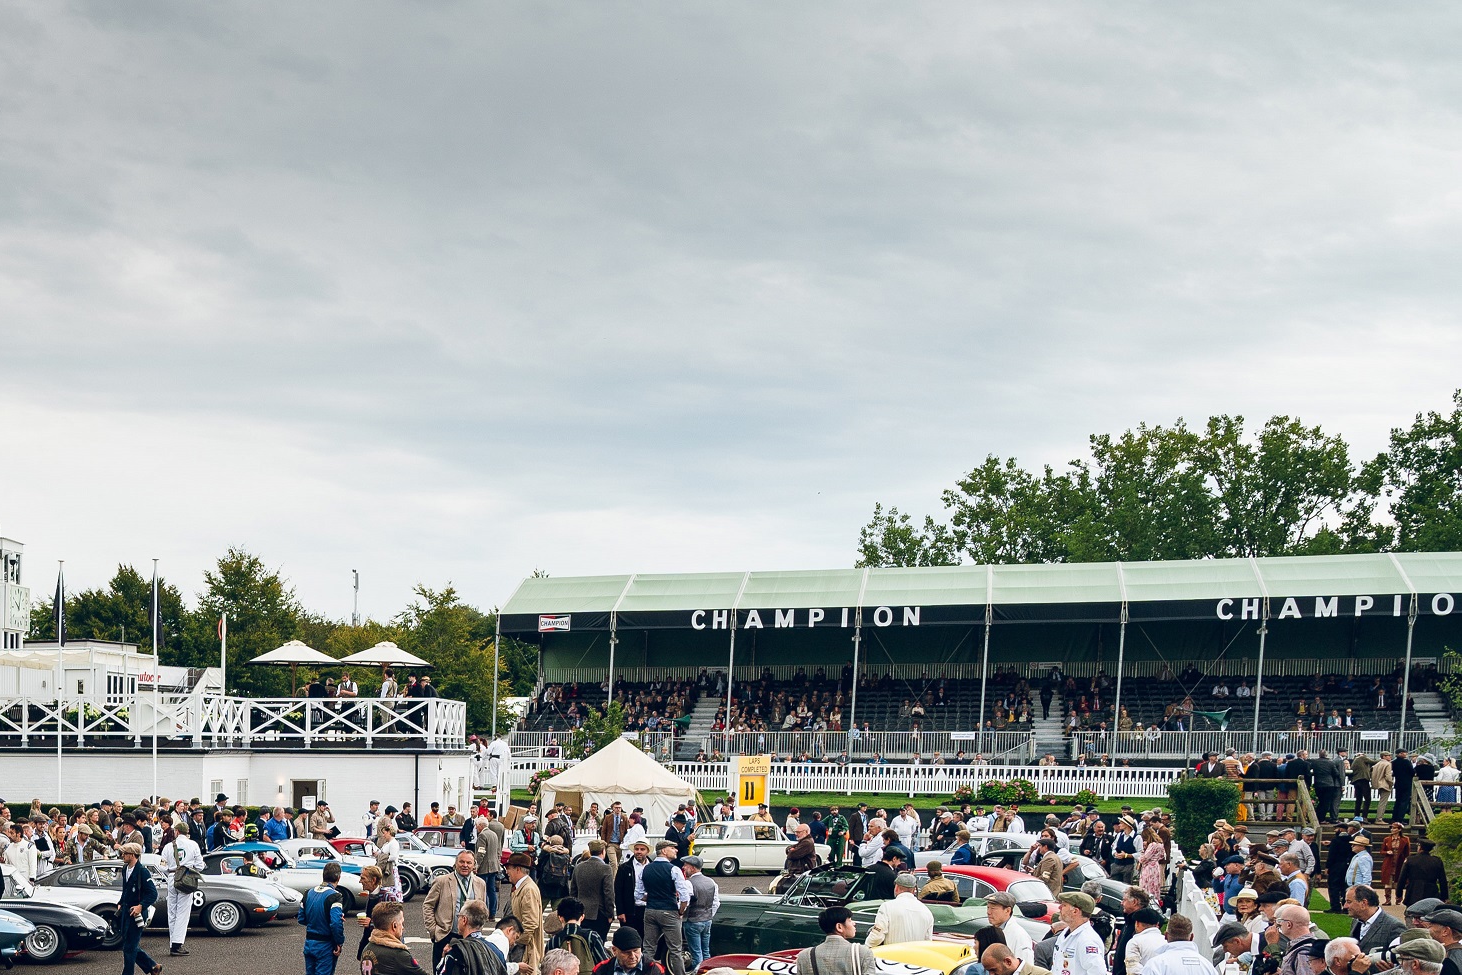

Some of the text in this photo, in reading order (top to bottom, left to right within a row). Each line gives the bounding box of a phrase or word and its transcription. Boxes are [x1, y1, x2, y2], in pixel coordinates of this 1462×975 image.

[691, 605, 921, 630] CHAMPION
[748, 757, 761, 765] LAPS
[741, 765, 768, 773] COMPLETED
[744, 781, 755, 801] 11
